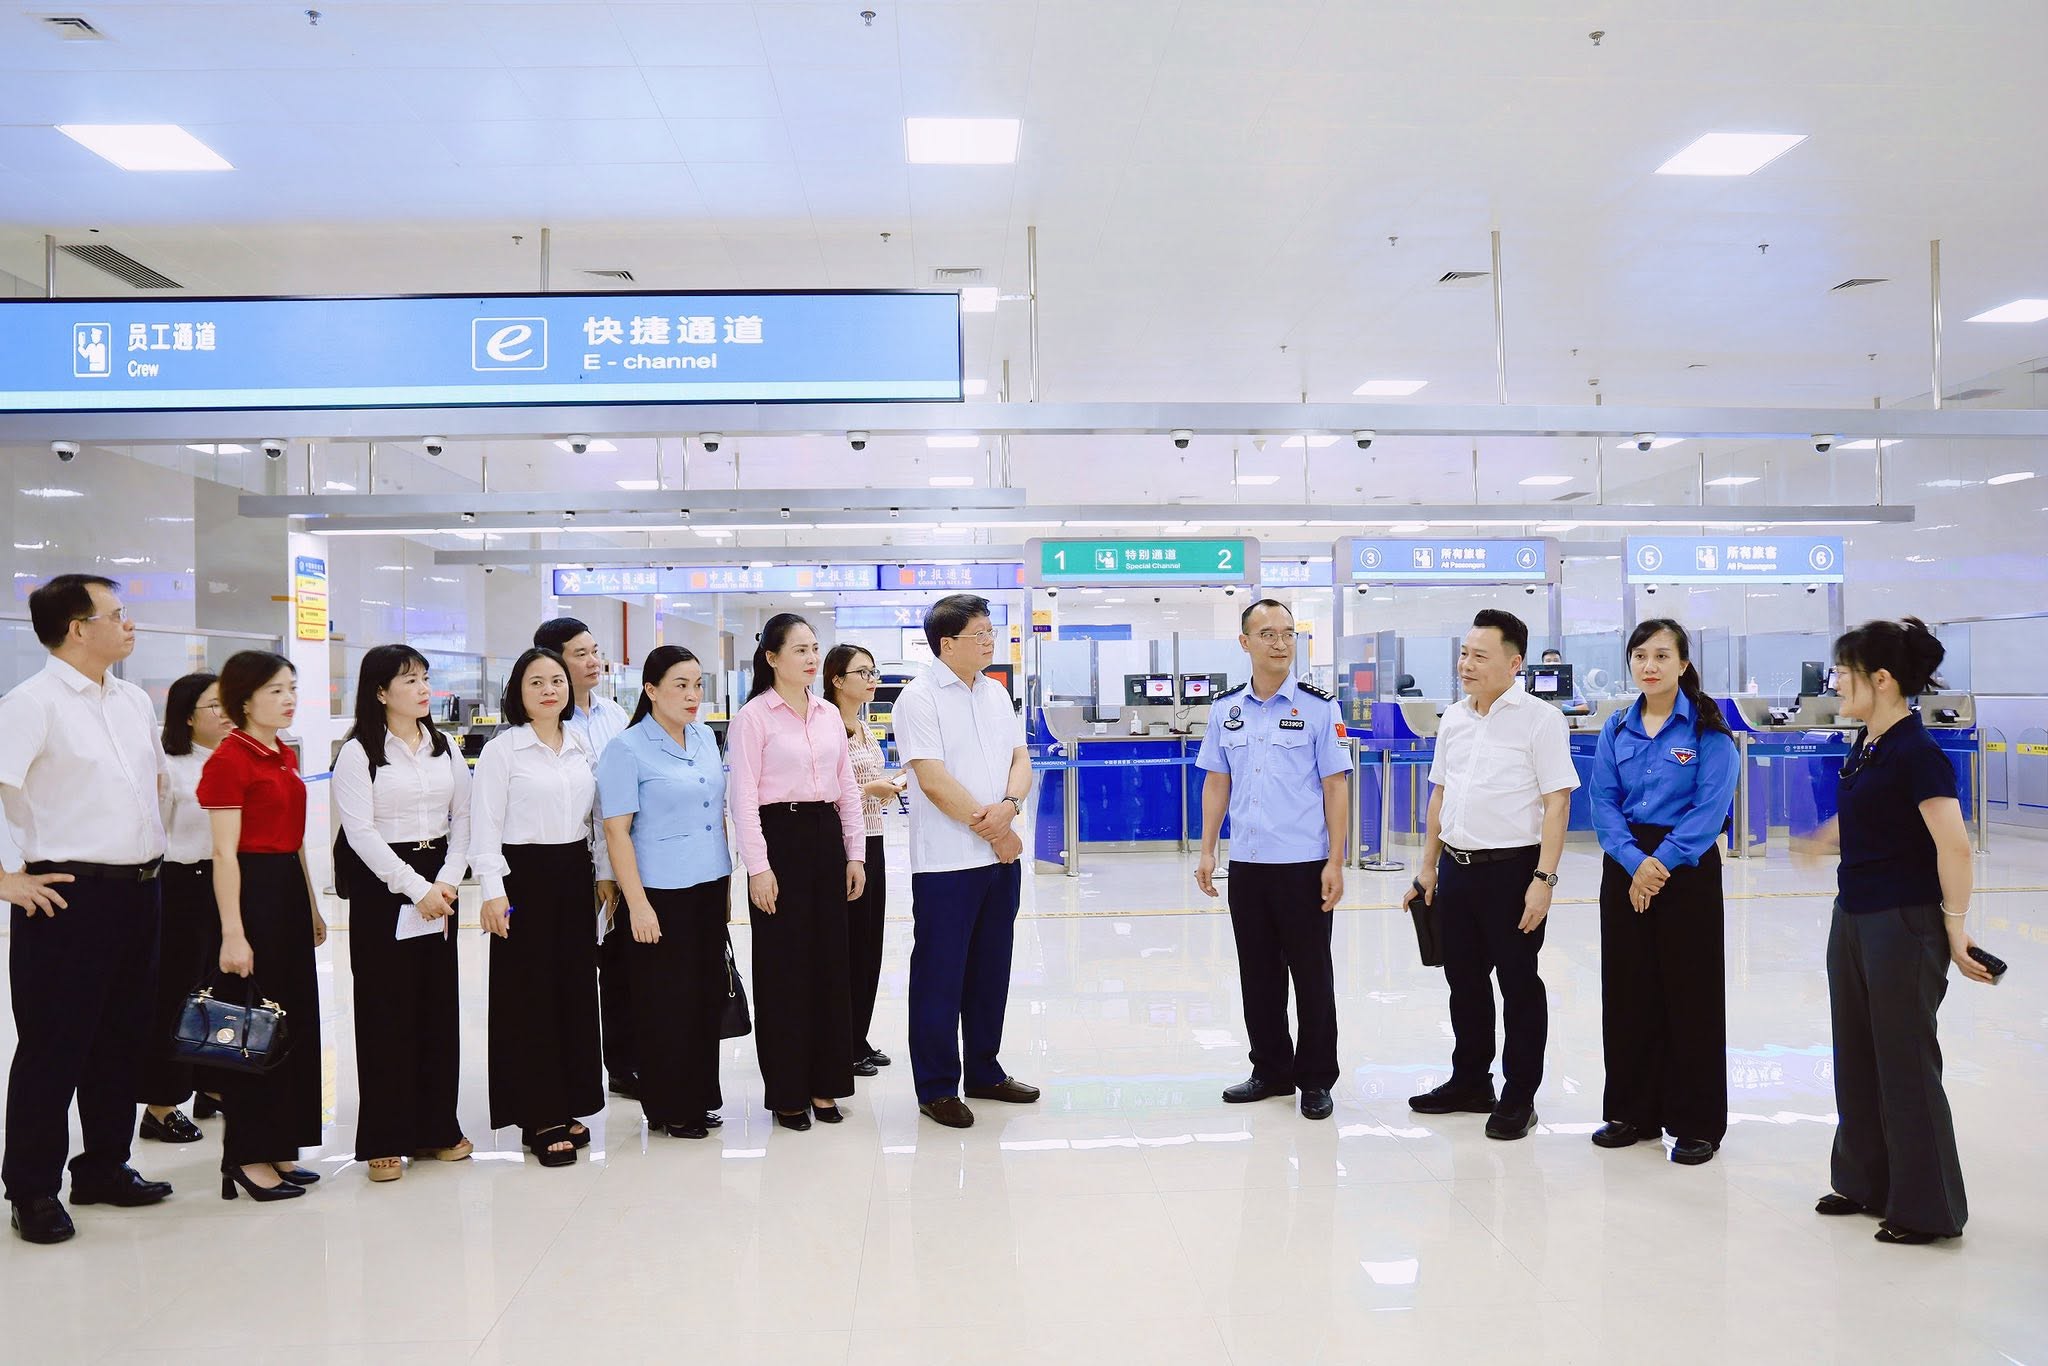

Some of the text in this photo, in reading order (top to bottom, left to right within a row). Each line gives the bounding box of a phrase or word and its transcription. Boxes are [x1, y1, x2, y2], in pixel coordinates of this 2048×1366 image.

[127, 321, 217, 352] 员工通道
[583, 316, 764, 345] 快捷通道
[127, 360, 160, 377] Crew
[623, 353, 717, 369] channel
[1054, 550, 1065, 570] 1
[1125, 548, 1177, 561] 特别通道
[1217, 549, 1233, 569] 2
[1440, 547, 1487, 560] 所有旅客
[1726, 545, 1778, 560] 所有旅客
[1125, 562, 1181, 571] Special Channel
